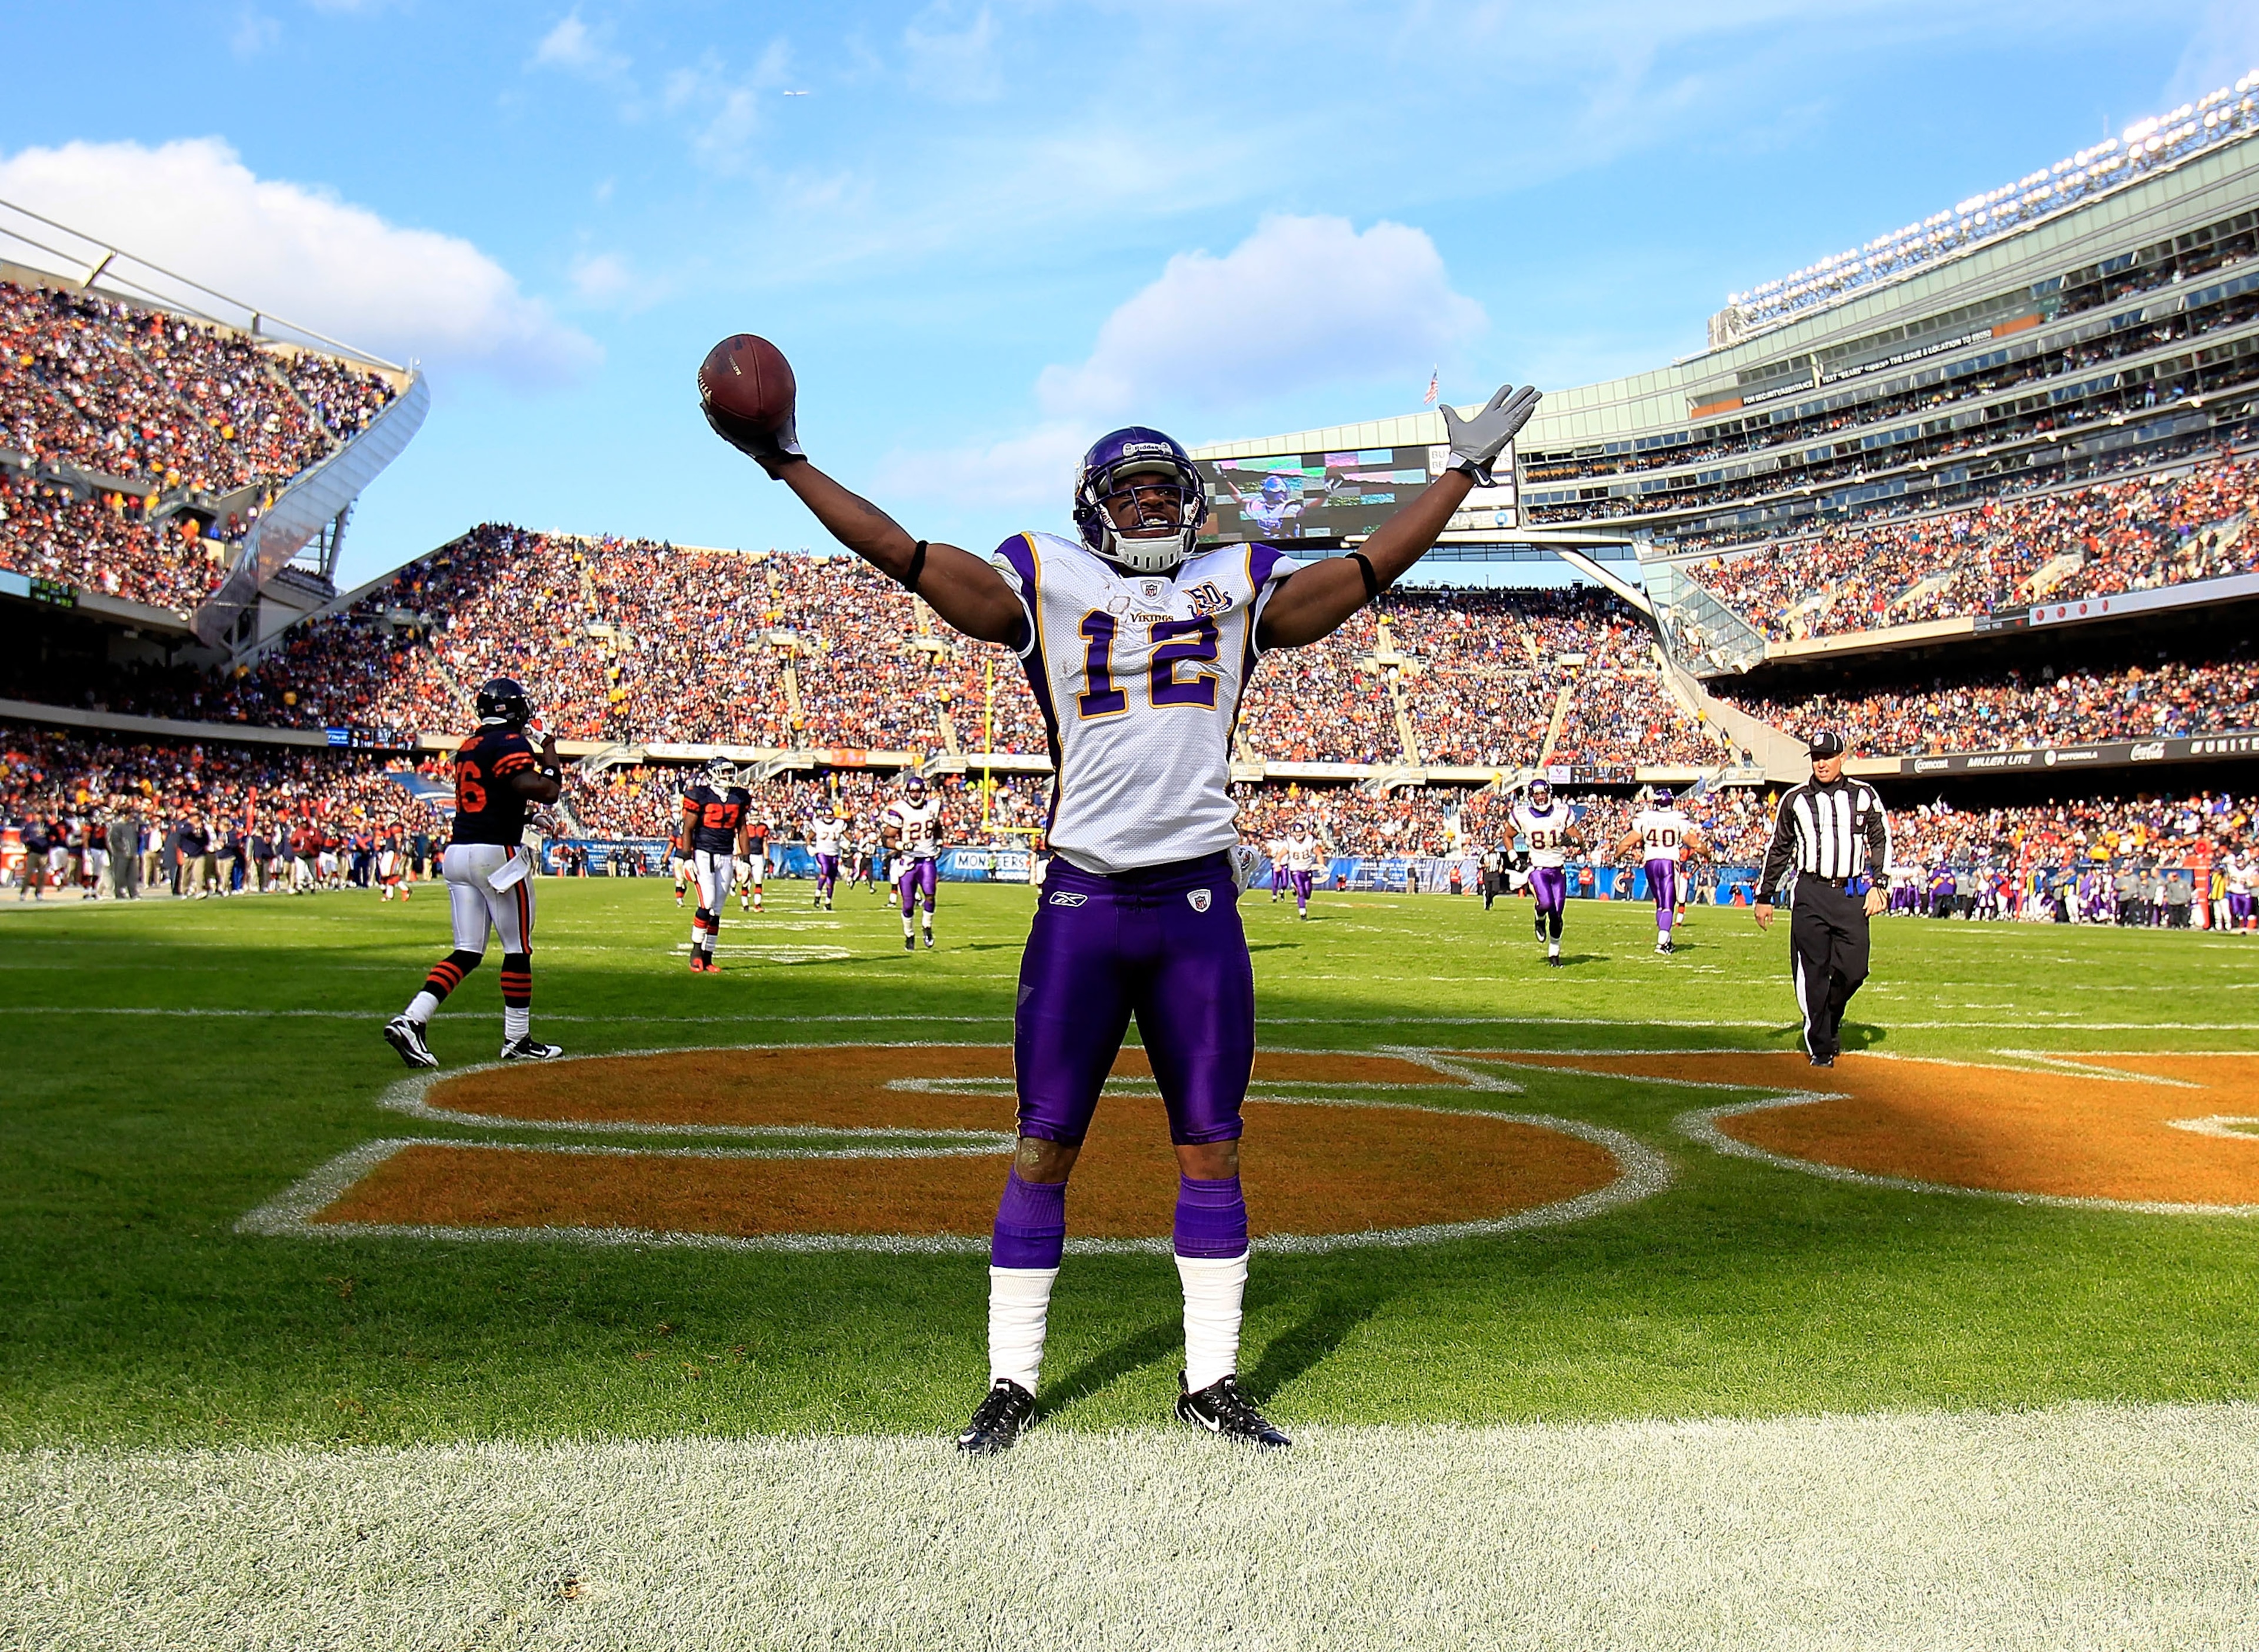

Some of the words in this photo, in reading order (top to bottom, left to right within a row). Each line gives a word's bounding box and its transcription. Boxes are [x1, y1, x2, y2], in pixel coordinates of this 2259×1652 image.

[1822, 373, 1838, 384] TEXT
[1890, 355, 1903, 365] THE
[1903, 349, 1923, 362] ISSUE
[1928, 338, 1961, 355] LOCATION
[1962, 335, 1971, 345] TO
[1432, 450, 1450, 459] BU
[1448, 513, 1492, 528] HASE
[1076, 607, 1221, 720] 12
[1967, 755, 2007, 768] MILLER
[2007, 754, 2033, 766] LITE
[2057, 751, 2098, 761] MOTOROLA
[703, 802, 739, 829] 27
[909, 820, 934, 841] 28
[1531, 829, 1558, 850] 81
[1646, 828, 1675, 848] 40
[958, 854, 1025, 868] MONTERS
